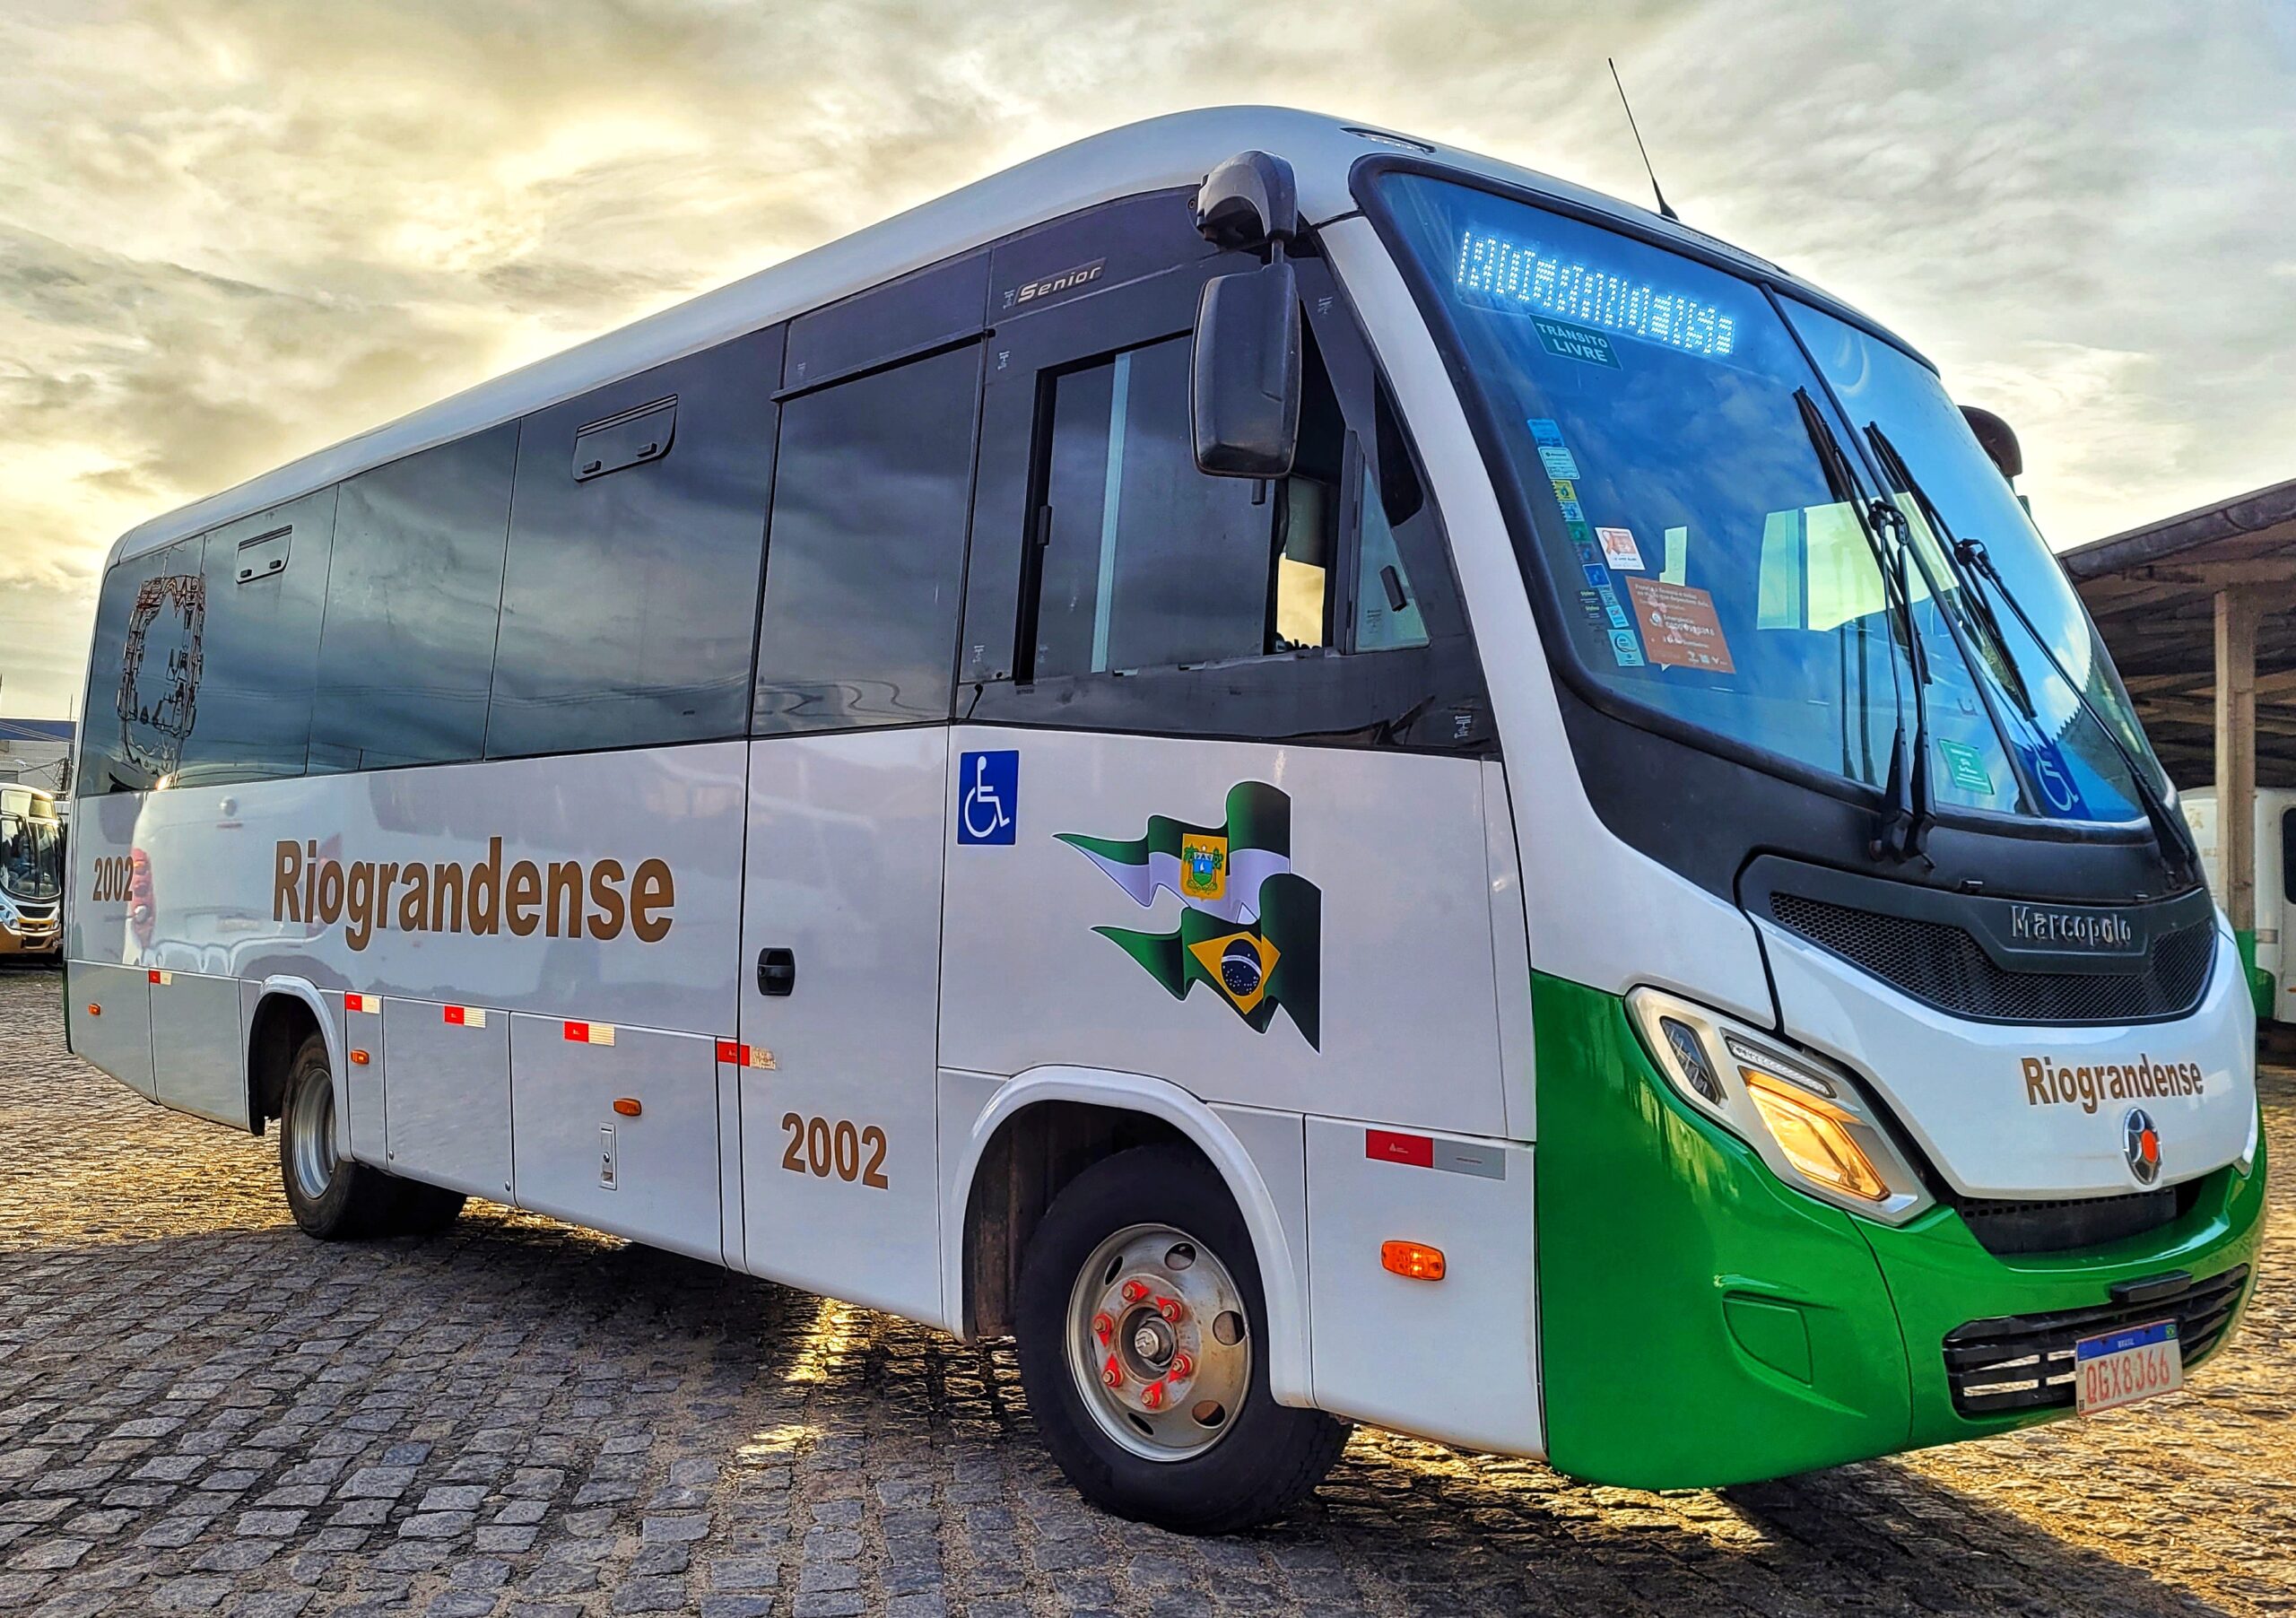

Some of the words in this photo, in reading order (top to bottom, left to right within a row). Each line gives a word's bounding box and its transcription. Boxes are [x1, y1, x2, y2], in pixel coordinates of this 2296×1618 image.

[1017, 265, 1101, 303] Senior
[1536, 322, 1609, 350] TRÂNSITO
[1553, 339, 1608, 362] LIVRE
[92, 856, 134, 902] 2002
[273, 836, 675, 952] Riograndense
[2010, 905, 2132, 947] Marcopolo
[2021, 1053, 2205, 1115] Riograndense
[781, 1111, 889, 1191] 2002
[2086, 1346, 2170, 1405] QGX8J66
